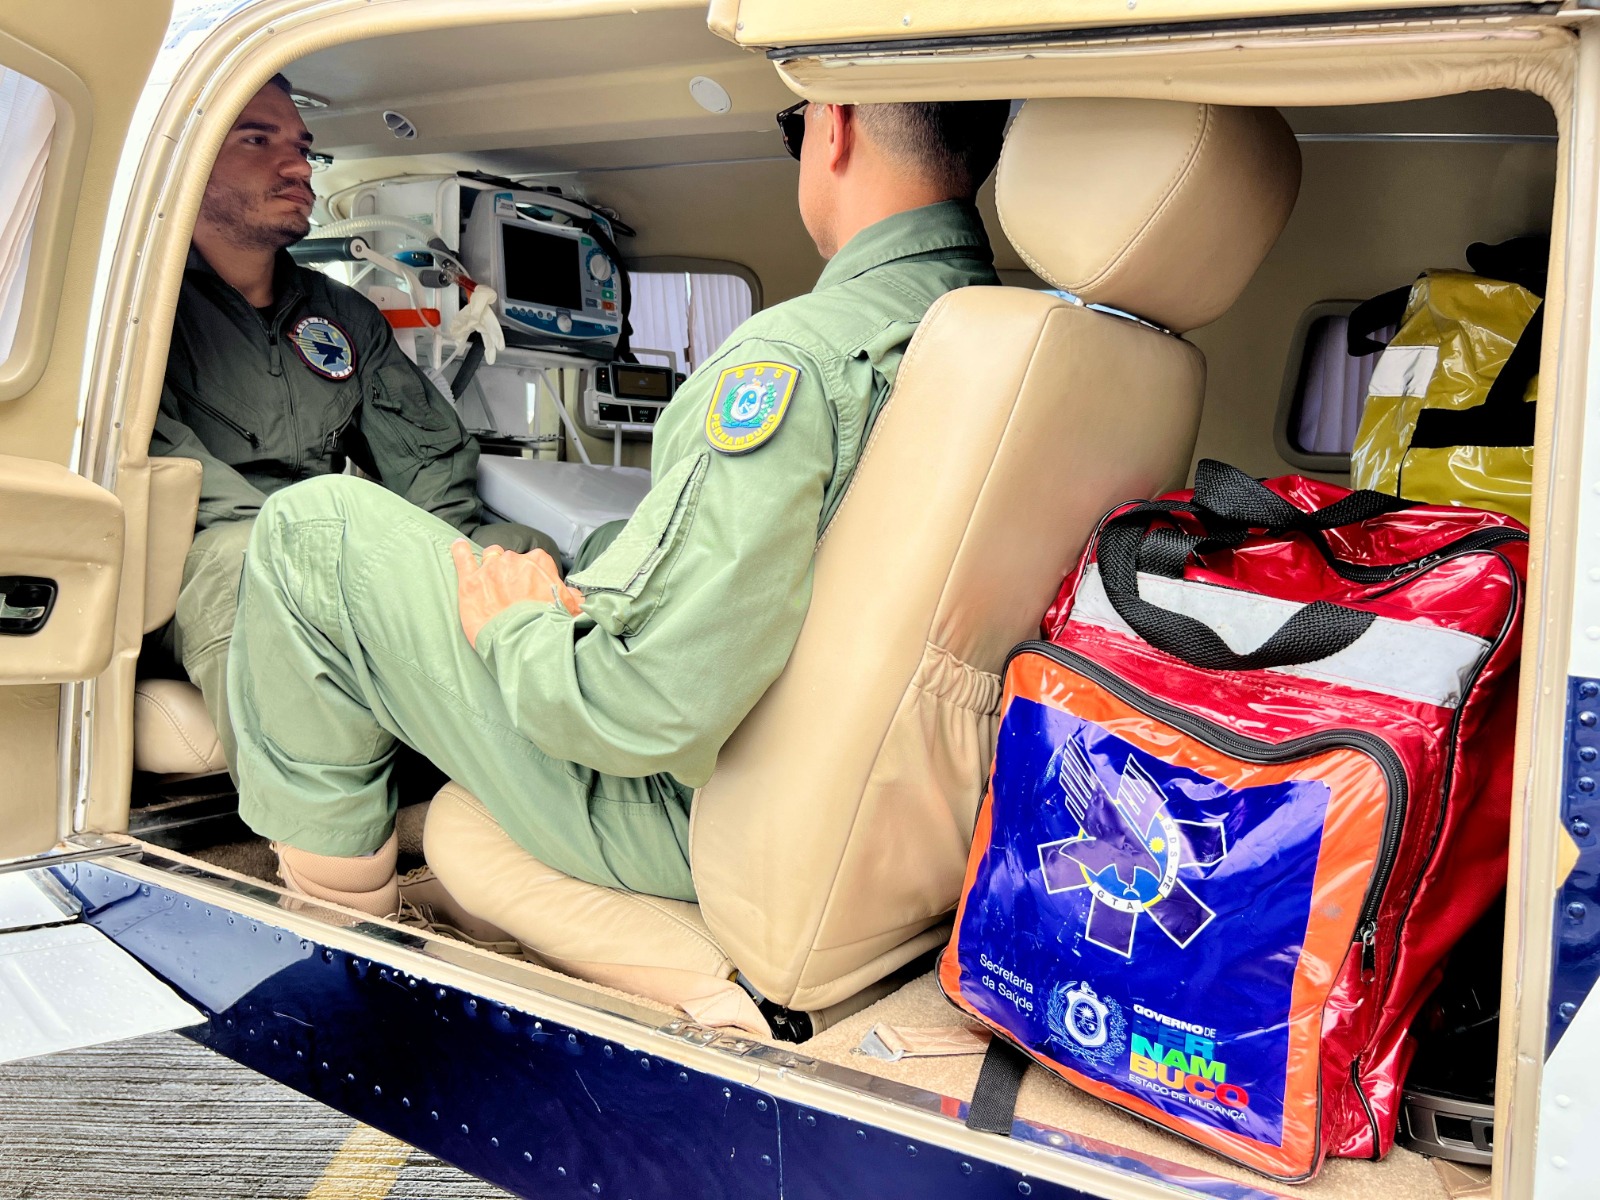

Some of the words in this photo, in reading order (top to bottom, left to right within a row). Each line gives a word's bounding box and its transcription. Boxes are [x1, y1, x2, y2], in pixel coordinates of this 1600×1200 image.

[711, 413, 777, 445] PERNAMBUCO
[1096, 889, 1134, 911] GTA
[980, 953, 1034, 994] Secretaria
[982, 974, 996, 990] da
[997, 982, 1034, 1011] Saúde
[1133, 1003, 1204, 1035] GOVERNO
[1203, 1026, 1217, 1038] DE
[1131, 1032, 1226, 1083] NAM
[1128, 1073, 1169, 1096] ESTADO
[1170, 1090, 1187, 1102] DE
[1188, 1096, 1248, 1121] MUDANÇA
[1129, 1051, 1249, 1108] BUCO
